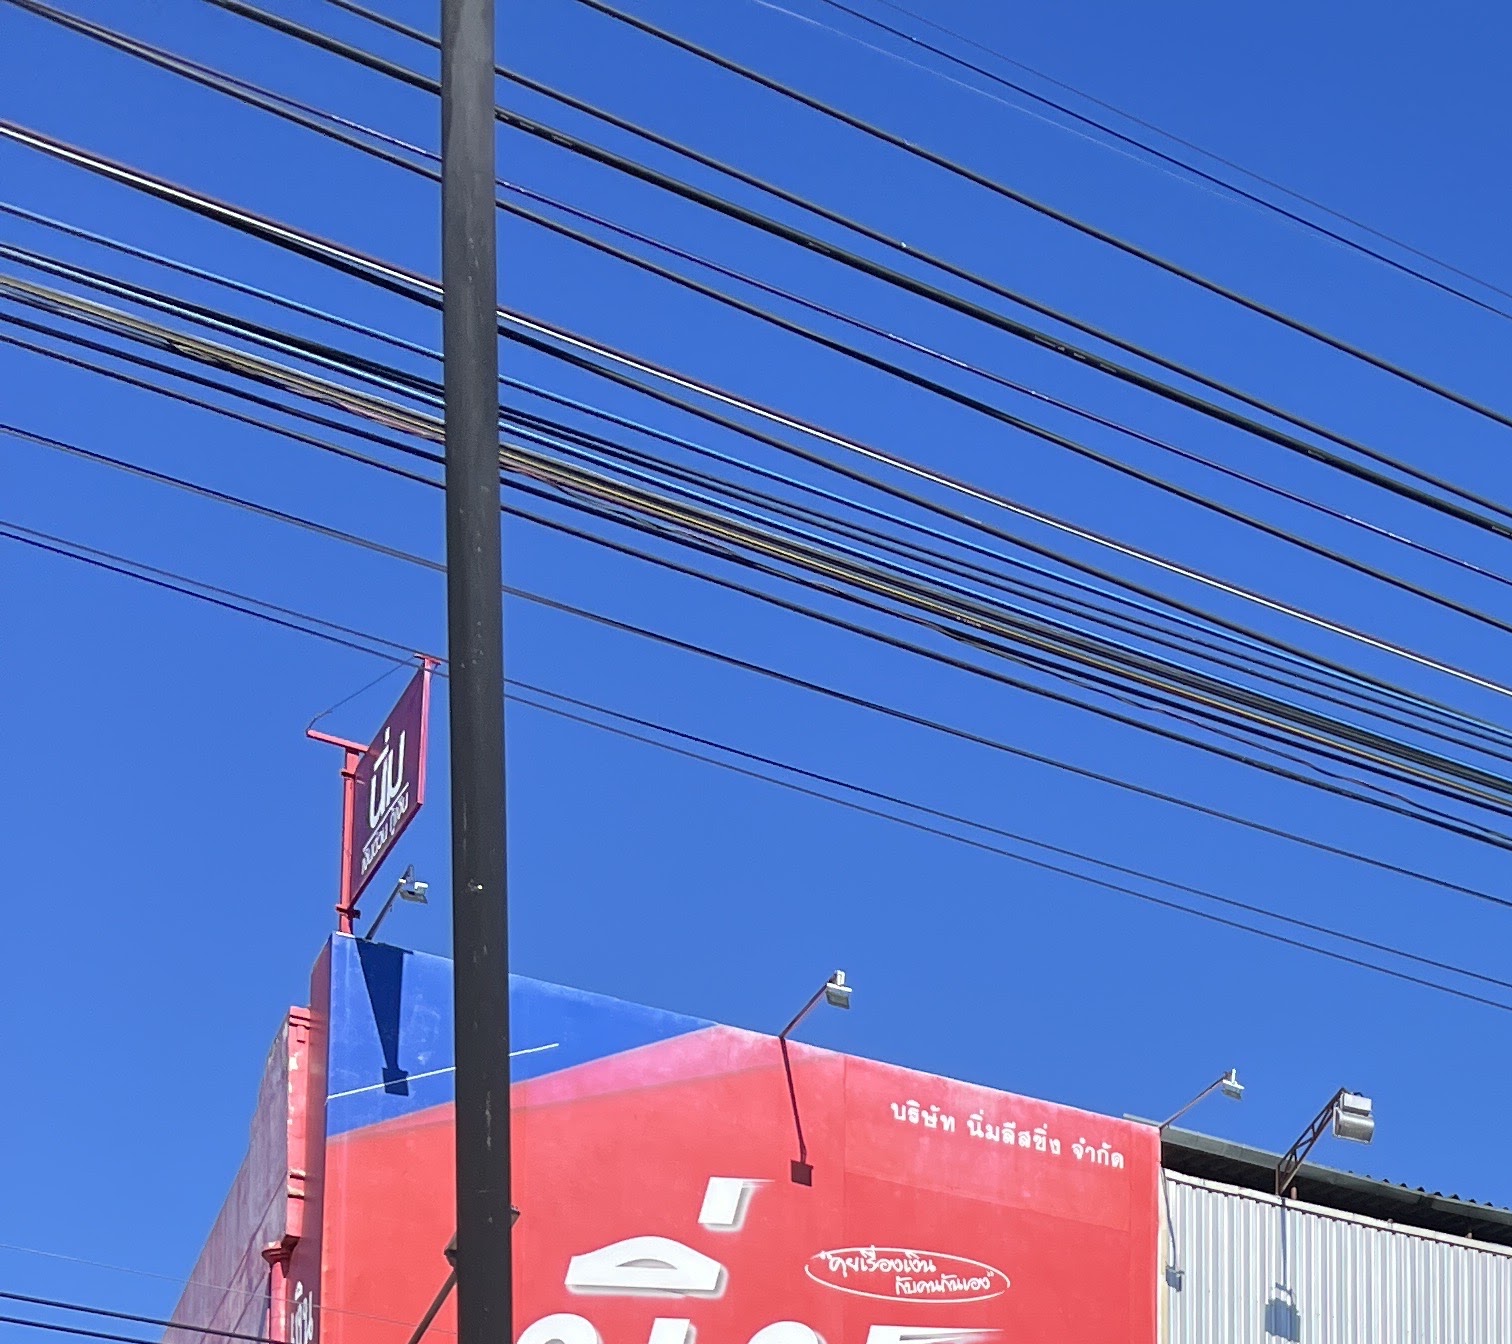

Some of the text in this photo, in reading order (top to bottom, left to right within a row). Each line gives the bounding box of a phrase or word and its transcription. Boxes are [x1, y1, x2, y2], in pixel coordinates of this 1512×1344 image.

[891, 1100, 1125, 1169] บริษัท นิ่มลีสซิ่ง จำกัด
